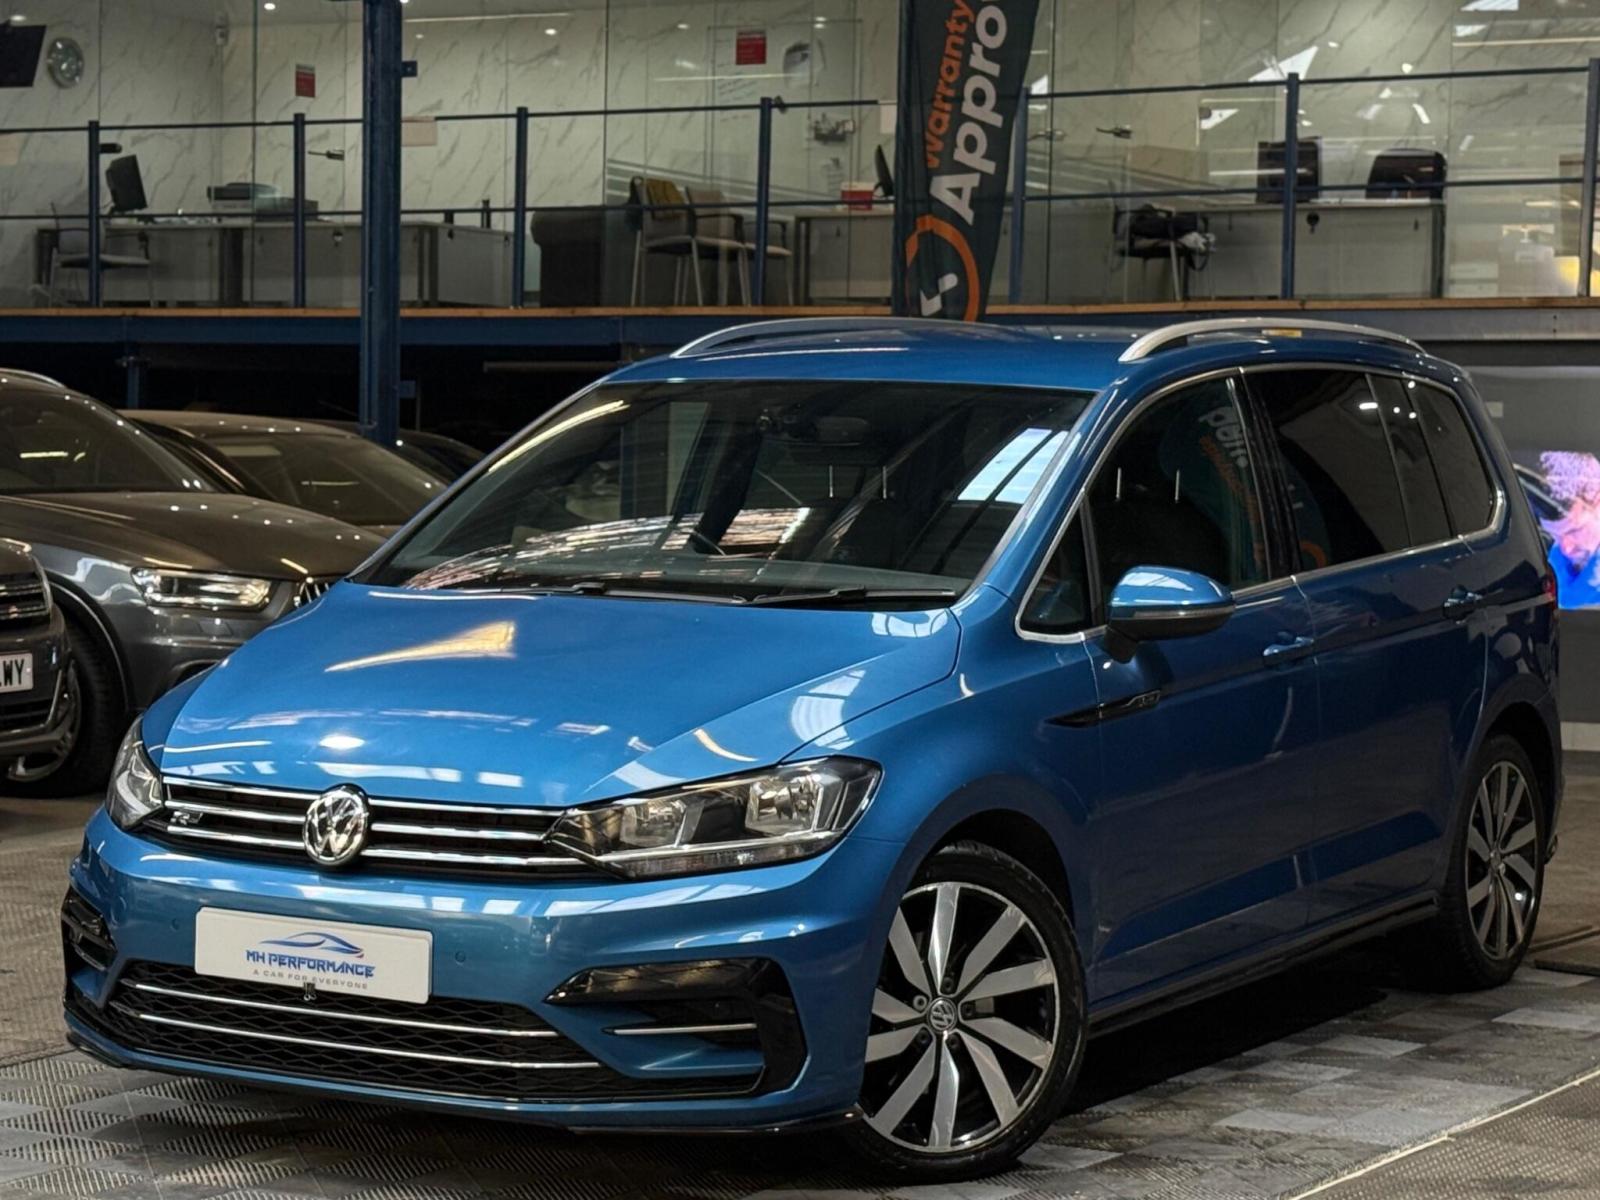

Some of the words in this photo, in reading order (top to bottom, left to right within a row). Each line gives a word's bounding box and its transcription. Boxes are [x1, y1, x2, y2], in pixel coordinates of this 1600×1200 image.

[929, 0, 1007, 226] Appro
[0, 658, 25, 687] WY
[246, 950, 265, 964] MH
[268, 952, 376, 978] PERFORMANCE
[263, 970, 284, 979] CAR
[288, 973, 308, 982] FOR
[312, 976, 368, 990] EVERYONE
